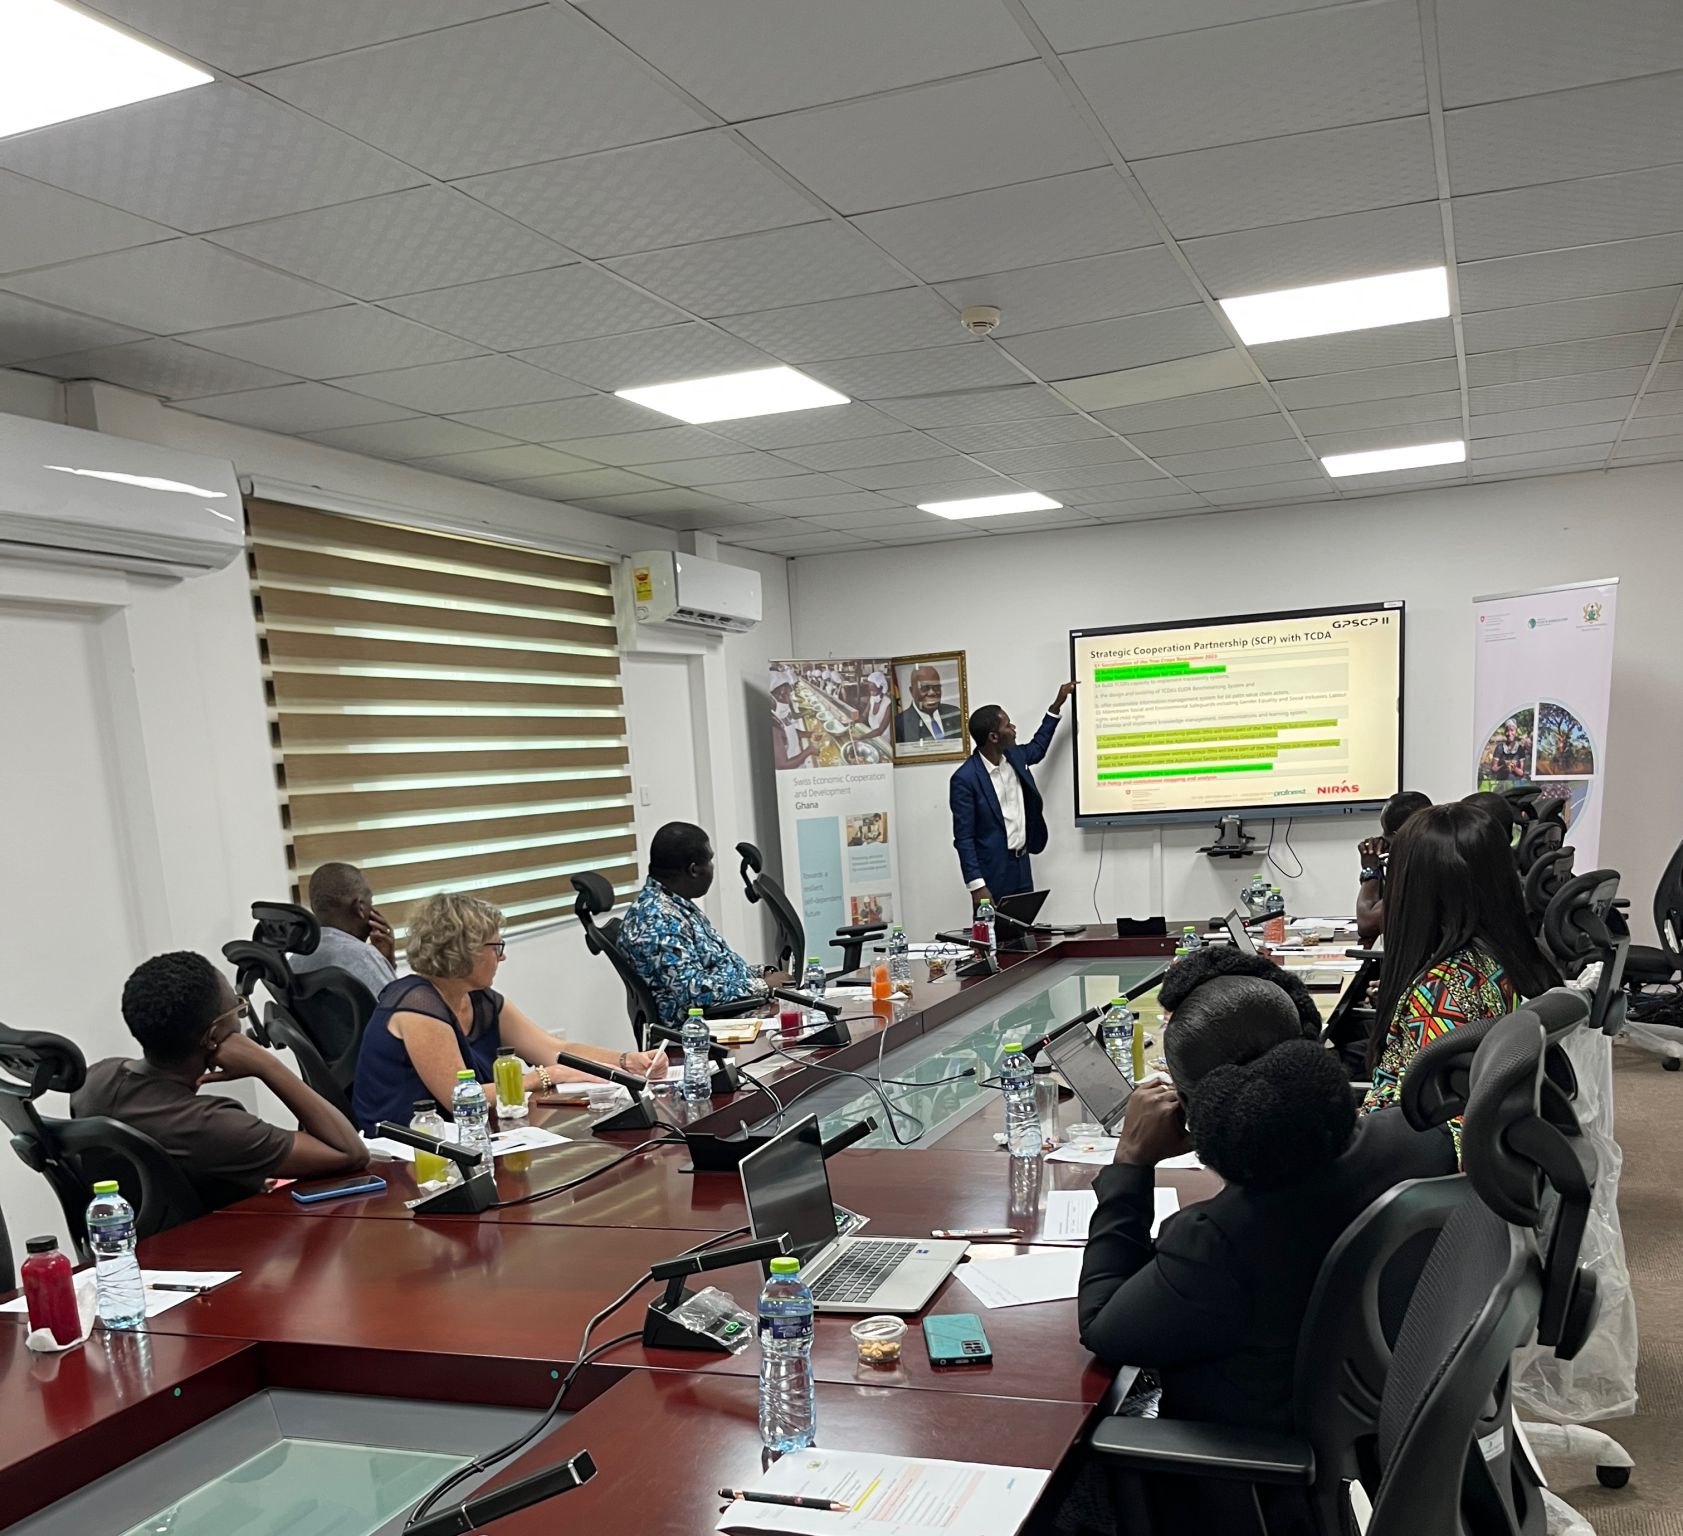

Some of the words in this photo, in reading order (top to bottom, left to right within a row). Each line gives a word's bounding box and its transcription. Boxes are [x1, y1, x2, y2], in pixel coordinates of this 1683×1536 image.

[1090, 649, 1131, 659] Strategic
[1133, 644, 1191, 655] Cooperation
[1193, 638, 1248, 650] Partnership
[1251, 635, 1277, 647] (SCP)
[1279, 633, 1301, 643] with
[1303, 631, 1332, 641] TCDA
[793, 777, 811, 786] Swiss
[813, 775, 844, 786] Economic
[845, 773, 886, 784] Cooperation
[794, 789, 807, 798] and
[809, 786, 851, 798] Development
[795, 801, 819, 810] Ghana
